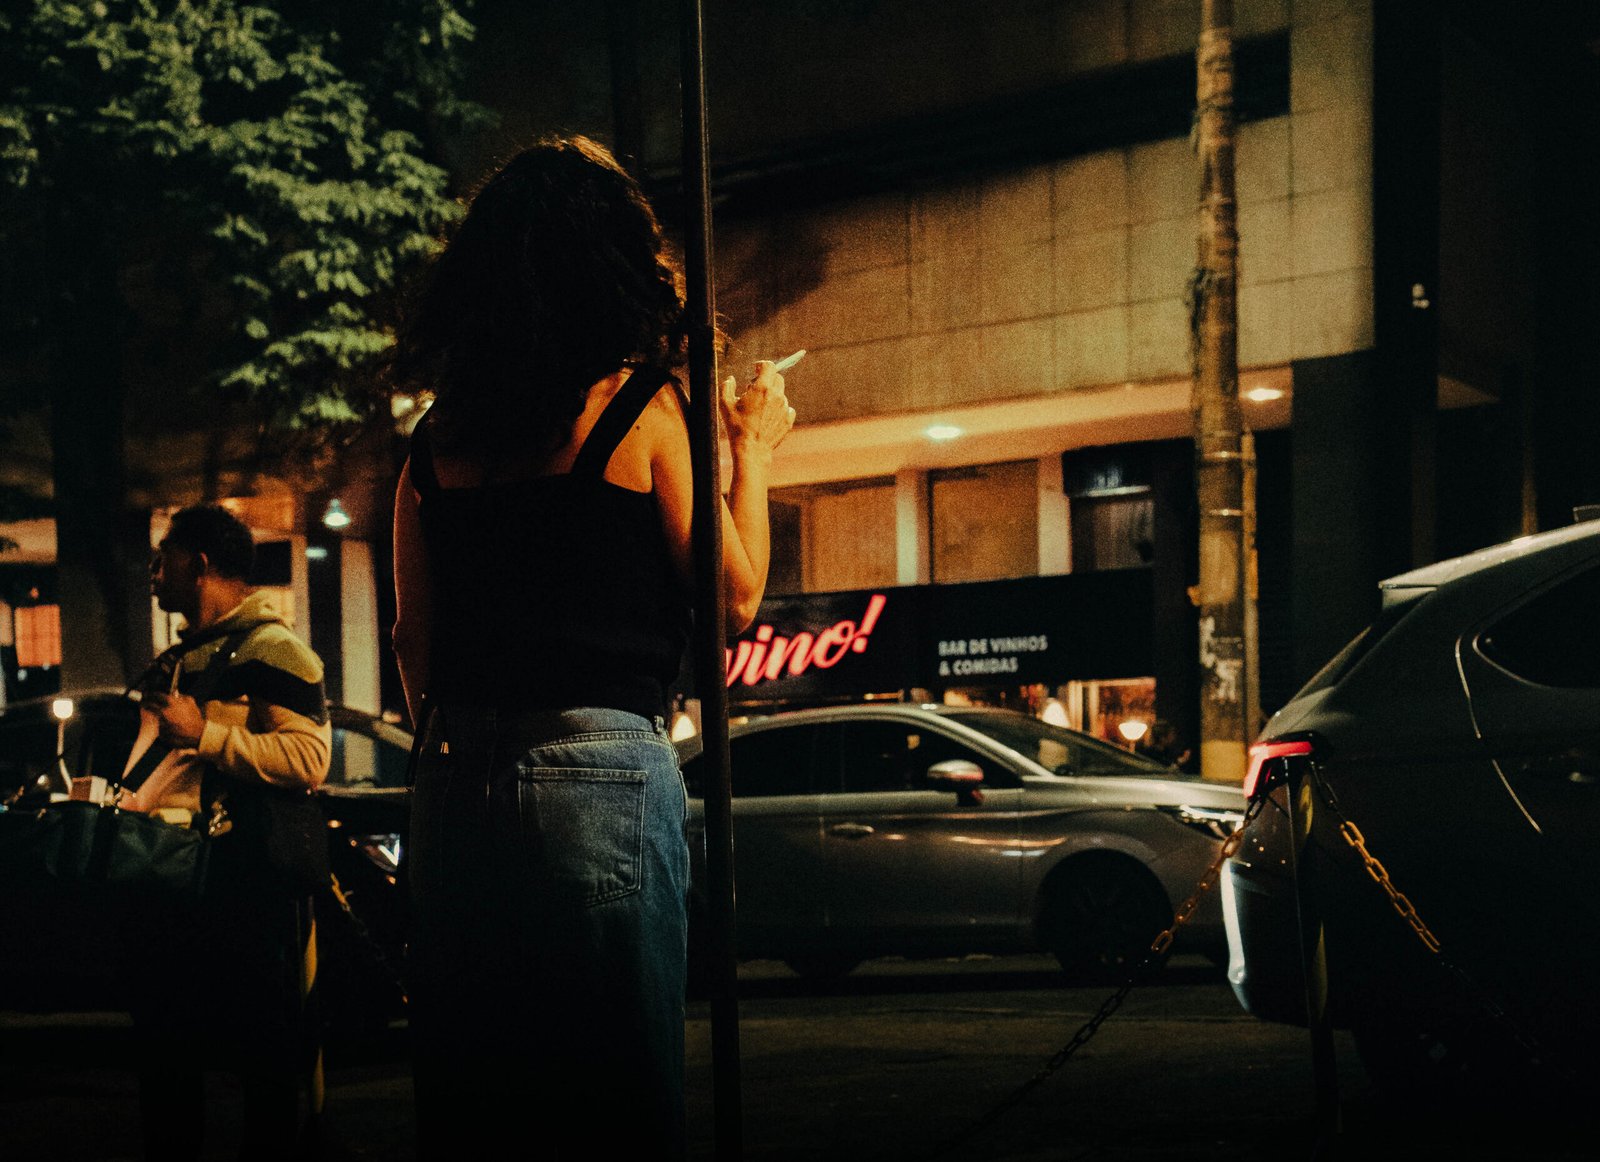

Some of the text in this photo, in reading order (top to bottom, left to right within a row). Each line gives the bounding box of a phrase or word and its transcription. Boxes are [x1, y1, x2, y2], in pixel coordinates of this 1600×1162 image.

[726, 594, 887, 688] vino!
[938, 635, 1048, 656] BAR DE VINHOS
[952, 657, 1018, 676] COMIDAS
